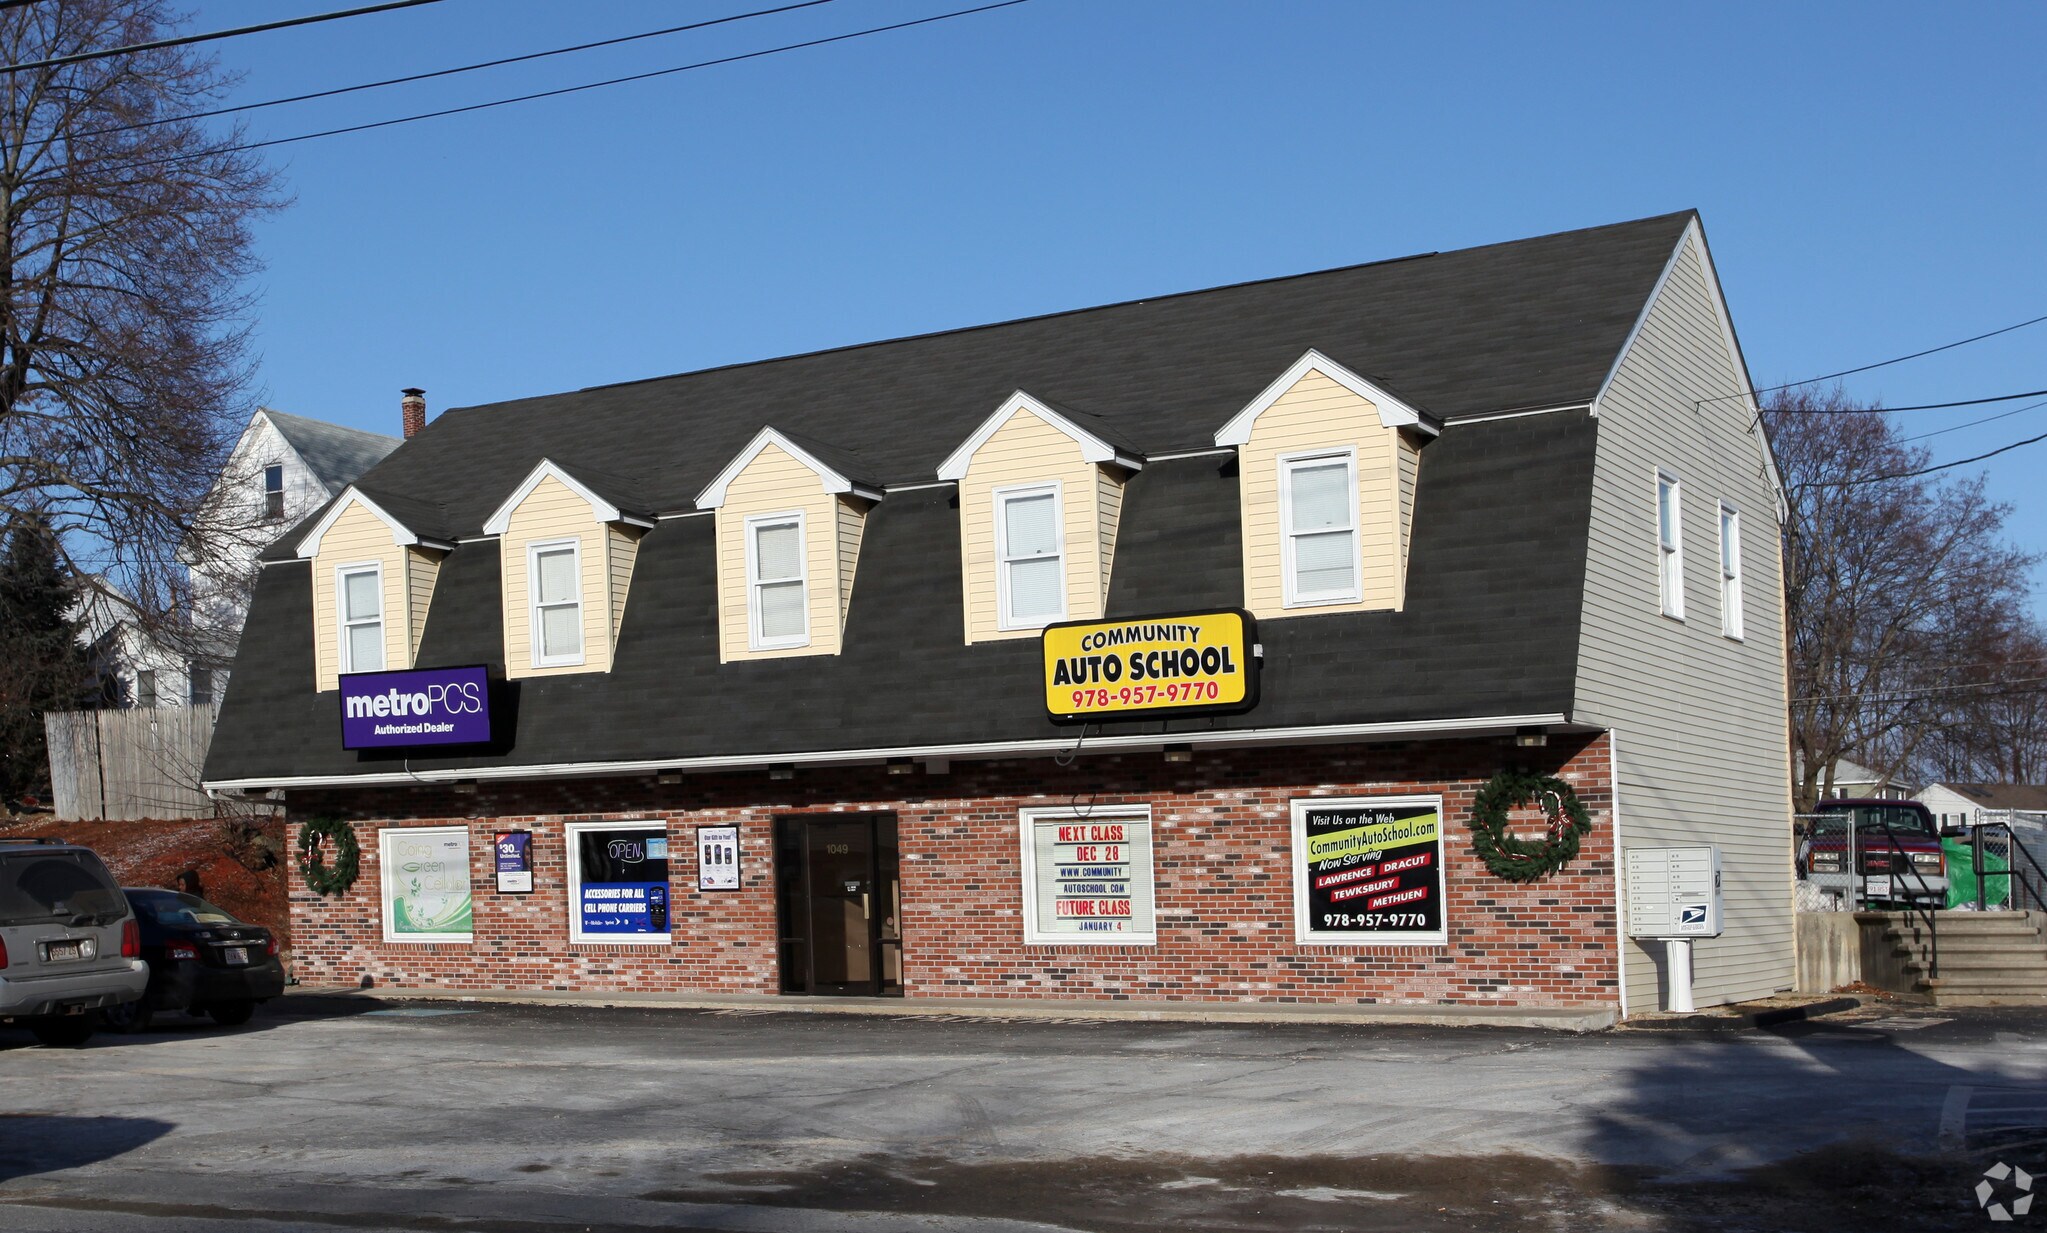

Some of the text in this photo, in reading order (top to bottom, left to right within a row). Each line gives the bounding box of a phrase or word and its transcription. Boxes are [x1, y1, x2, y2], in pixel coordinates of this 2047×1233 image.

[1082, 625, 1200, 651] COMMUNITY
[1053, 647, 1234, 685] AUTO SCHOOL
[1072, 681, 1218, 708] 978-957-9770
[374, 722, 454, 735] Authorized Dealer
[1312, 815, 1330, 826] Visit
[1332, 815, 1342, 824] Us
[1359, 814, 1372, 824] the
[1376, 812, 1394, 824] Web
[1059, 826, 1123, 841] NEXT CLASS
[1310, 822, 1434, 855] CommunityAutoSchool.com
[609, 843, 641, 858] OPEN
[826, 844, 848, 854] 1049
[1077, 846, 1119, 861] DEC 28
[1319, 848, 1382, 871] Now Serving
[402, 862, 445, 873] Green
[1060, 868, 1122, 877] WWW.COMMUNITY
[1318, 856, 1425, 887] LAWRENCE DRACUT
[584, 889, 620, 899] ACCESSORIES
[622, 889, 633, 898] FOR
[634, 889, 644, 898] ALL
[1064, 884, 1125, 893] AUTOSCHOOL.COM
[1334, 880, 1394, 900] TEWKSBURY
[1372, 890, 1422, 908] METHUEN
[584, 903, 646, 913] CELL PHONE CARRIERS
[1056, 900, 1130, 915] FUTURE CLASS
[1079, 922, 1122, 931] JANUARY 4
[1324, 914, 1426, 926] 978-957-9770
